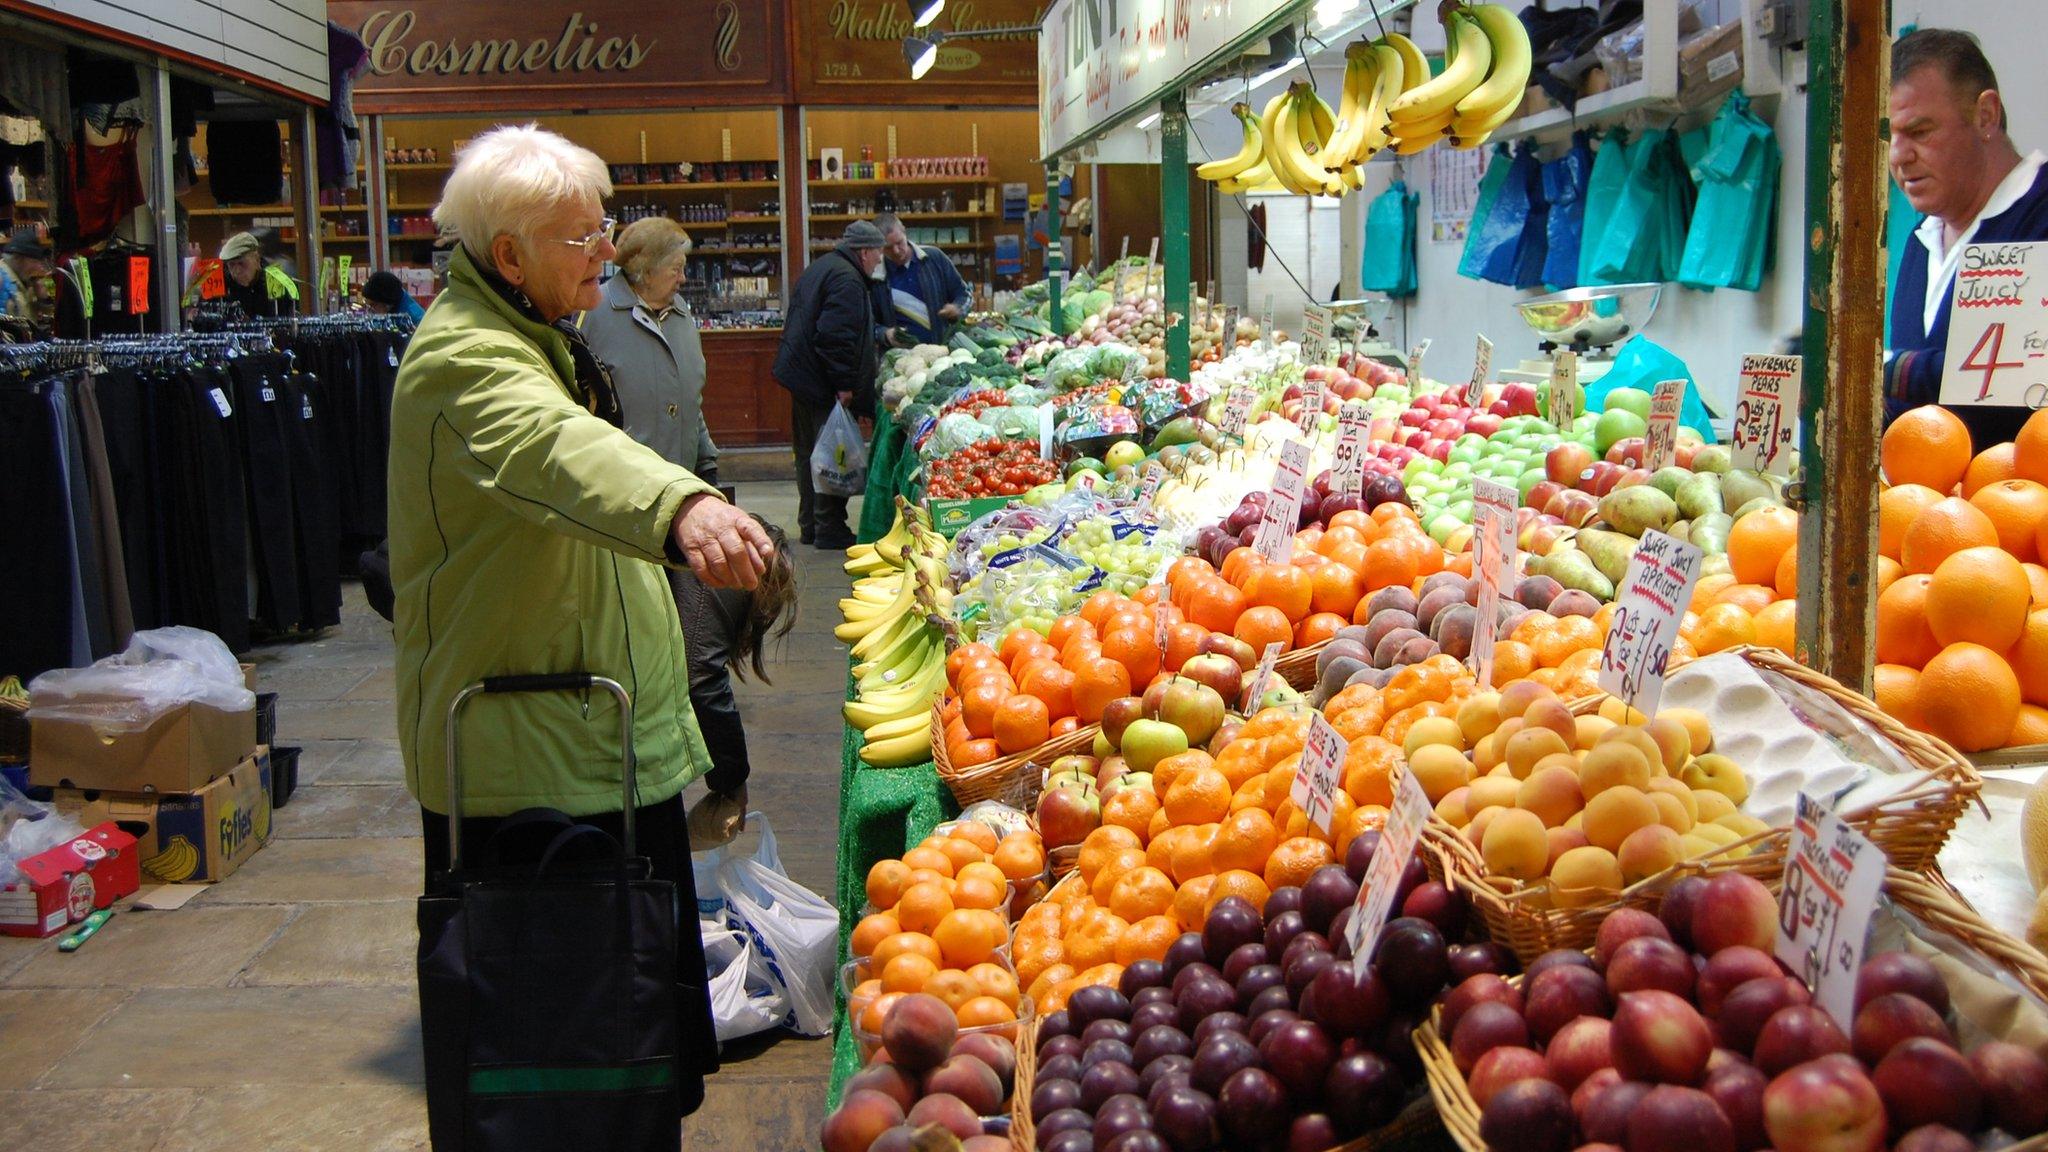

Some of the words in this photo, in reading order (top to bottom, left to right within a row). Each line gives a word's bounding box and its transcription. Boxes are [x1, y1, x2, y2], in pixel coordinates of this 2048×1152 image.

[361, 10, 657, 76] Cosmetics
[824, 63, 848, 76] 172
[852, 63, 861, 76] A
[1964, 245, 2033, 270] SWEET
[1959, 277, 2030, 300] JUICY
[1751, 376, 1781, 393] PEARS
[1958, 322, 2024, 402] 4
[1731, 400, 1750, 450] 2
[1639, 532, 1669, 558] SWEET
[1671, 546, 1695, 576] JUICY
[1639, 565, 1682, 604] APRICOTS
[1600, 606, 1628, 672] 2
[219, 807, 252, 861] Fyffes
[1779, 859, 1803, 942] 8
